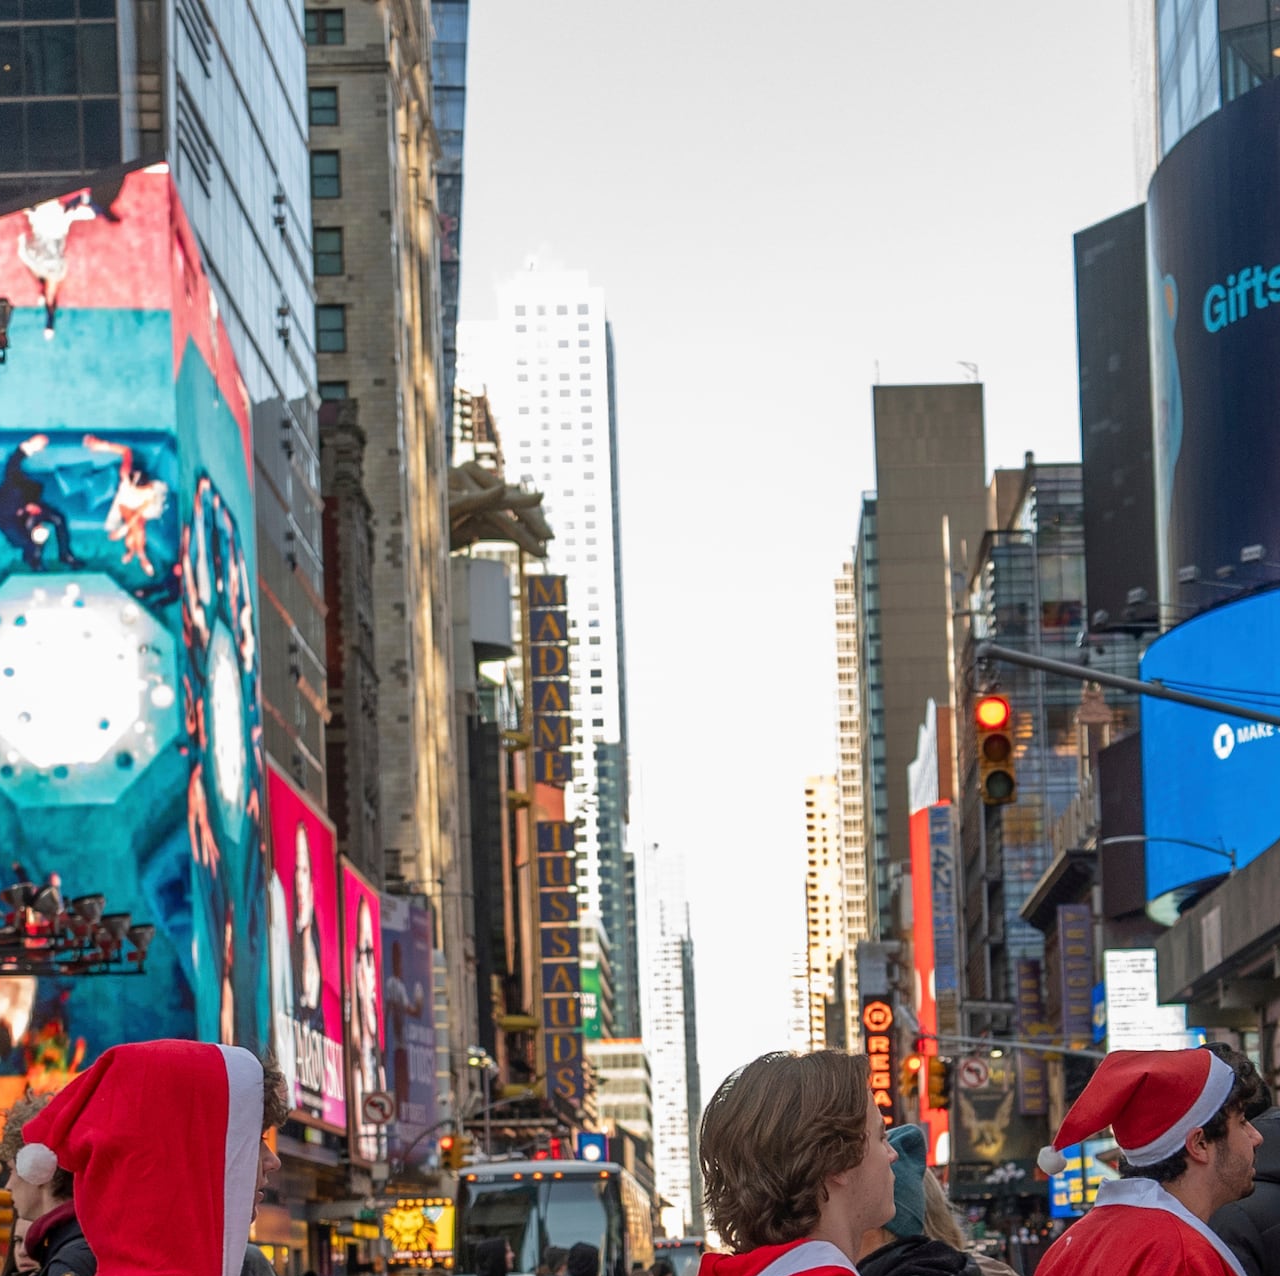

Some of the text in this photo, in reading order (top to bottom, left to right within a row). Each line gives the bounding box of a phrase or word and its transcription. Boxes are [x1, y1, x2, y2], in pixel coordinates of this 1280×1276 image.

[532, 576, 569, 782] MADAME
[1236, 721, 1275, 744] MAKE
[542, 820, 578, 1098] TUSSAUDS
